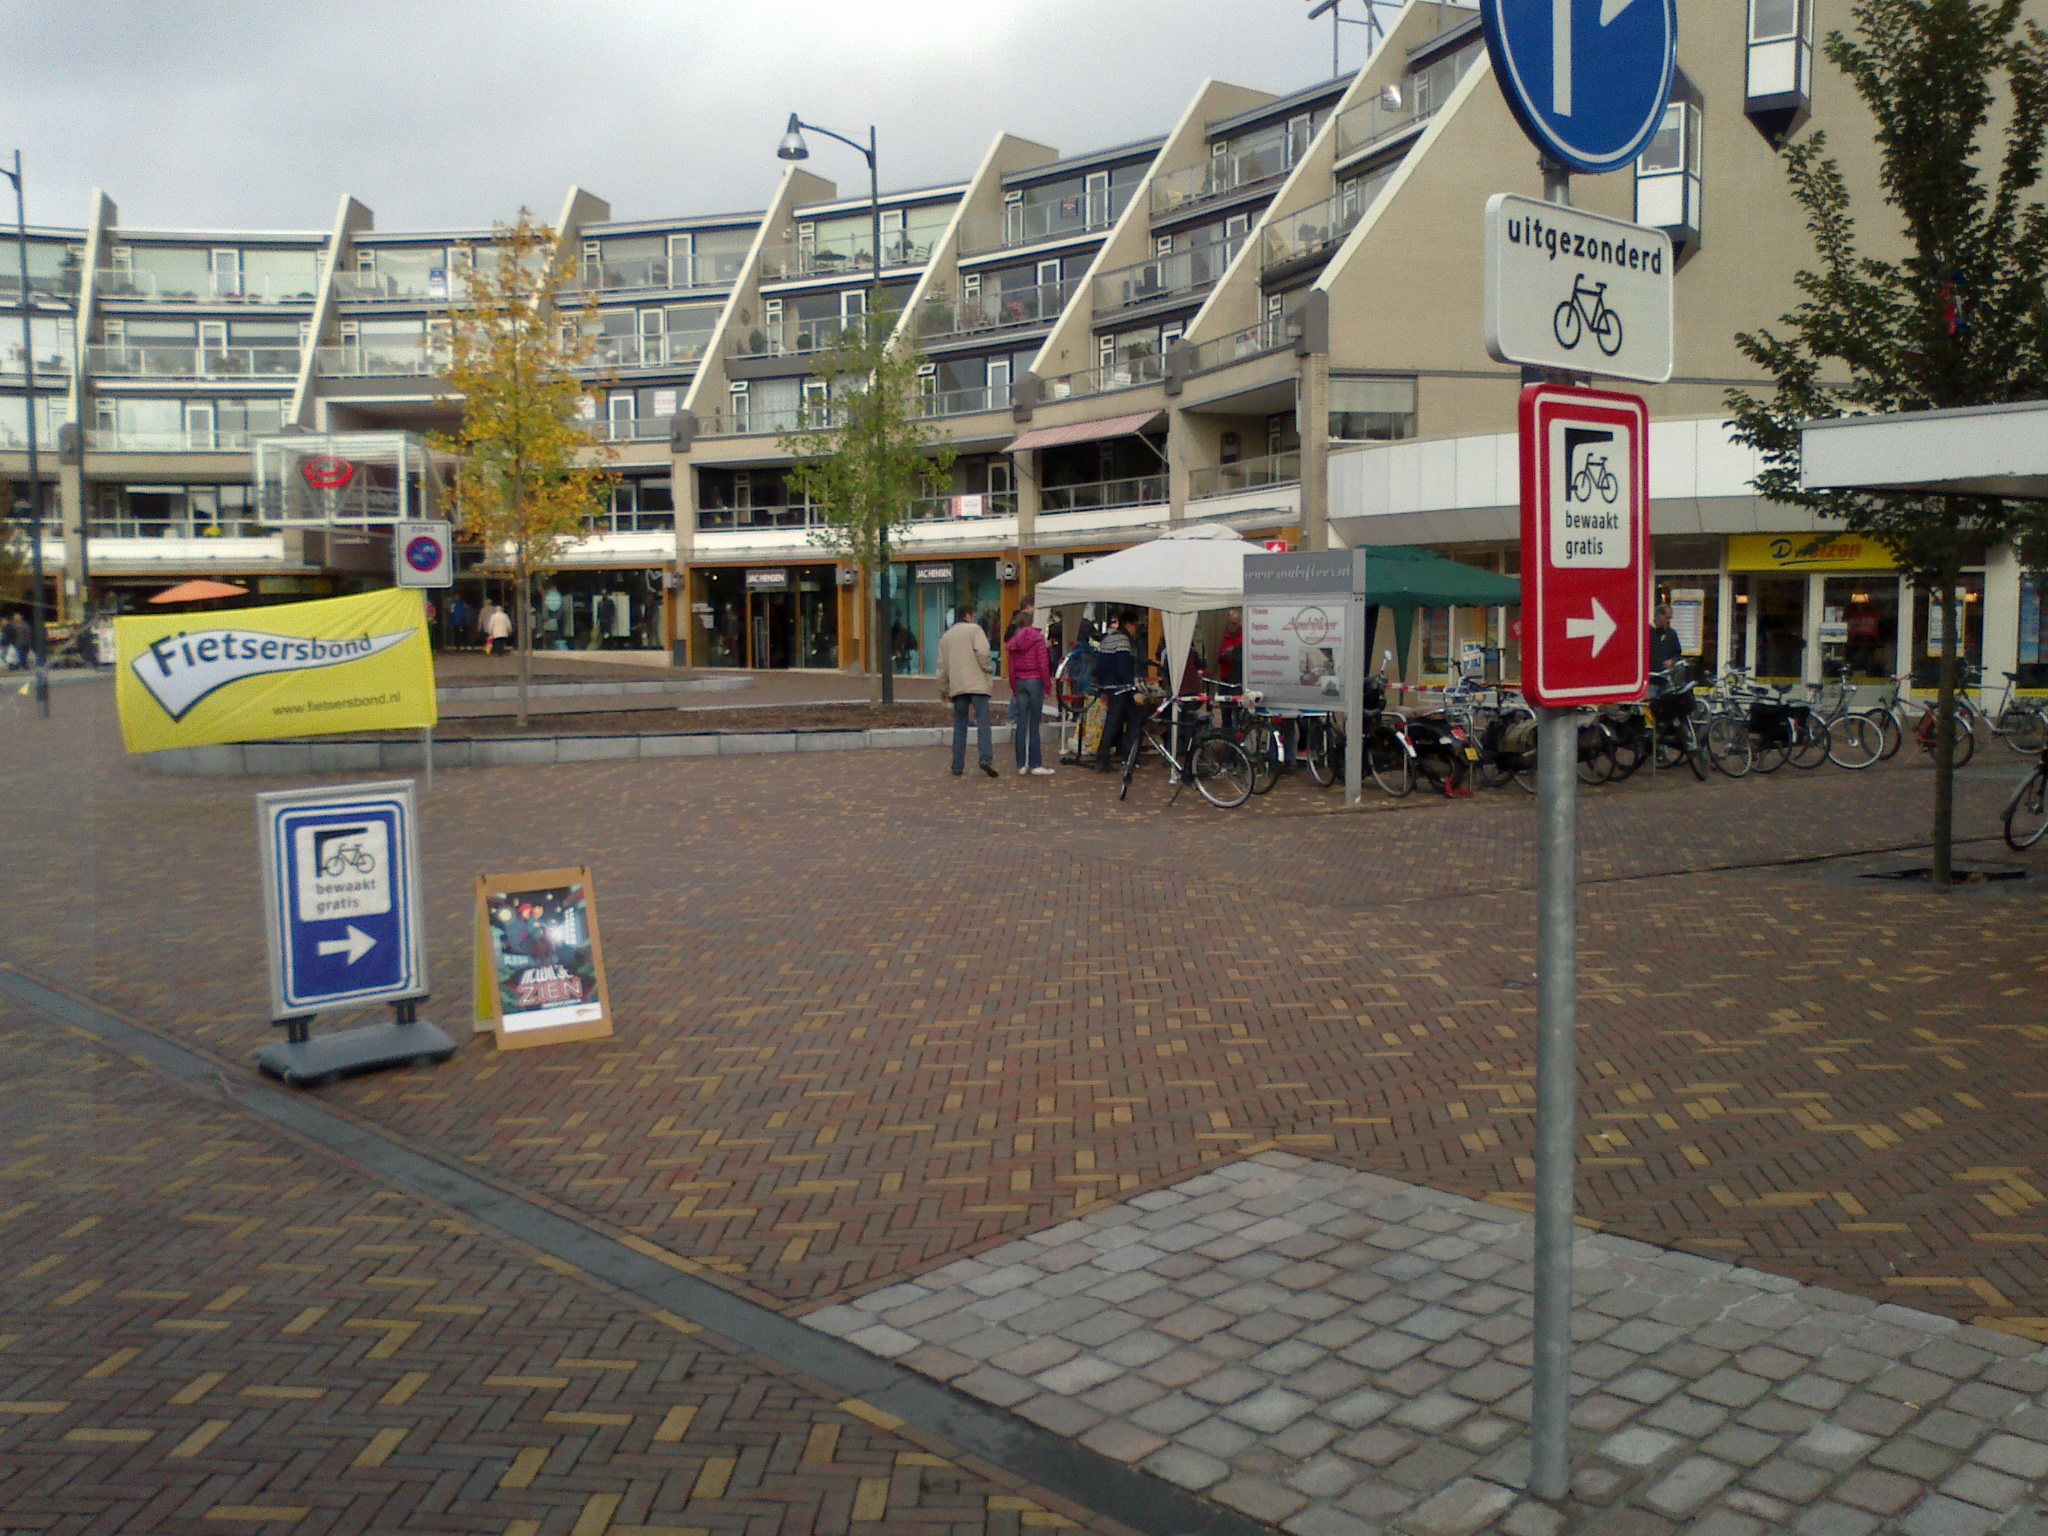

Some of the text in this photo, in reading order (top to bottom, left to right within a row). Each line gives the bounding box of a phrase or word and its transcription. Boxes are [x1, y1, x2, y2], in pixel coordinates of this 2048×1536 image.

[1508, 216, 1662, 275] uitgezonderd
[1565, 510, 1619, 529] bewaakt
[1565, 537, 1604, 559] gratis
[150, 631, 372, 678] Fietsersbond
[272, 692, 401, 716] www.fietsersbond.nl
[316, 878, 377, 895] bewaakt
[316, 898, 360, 915] gratis
[518, 977, 582, 1006] ZIEN
